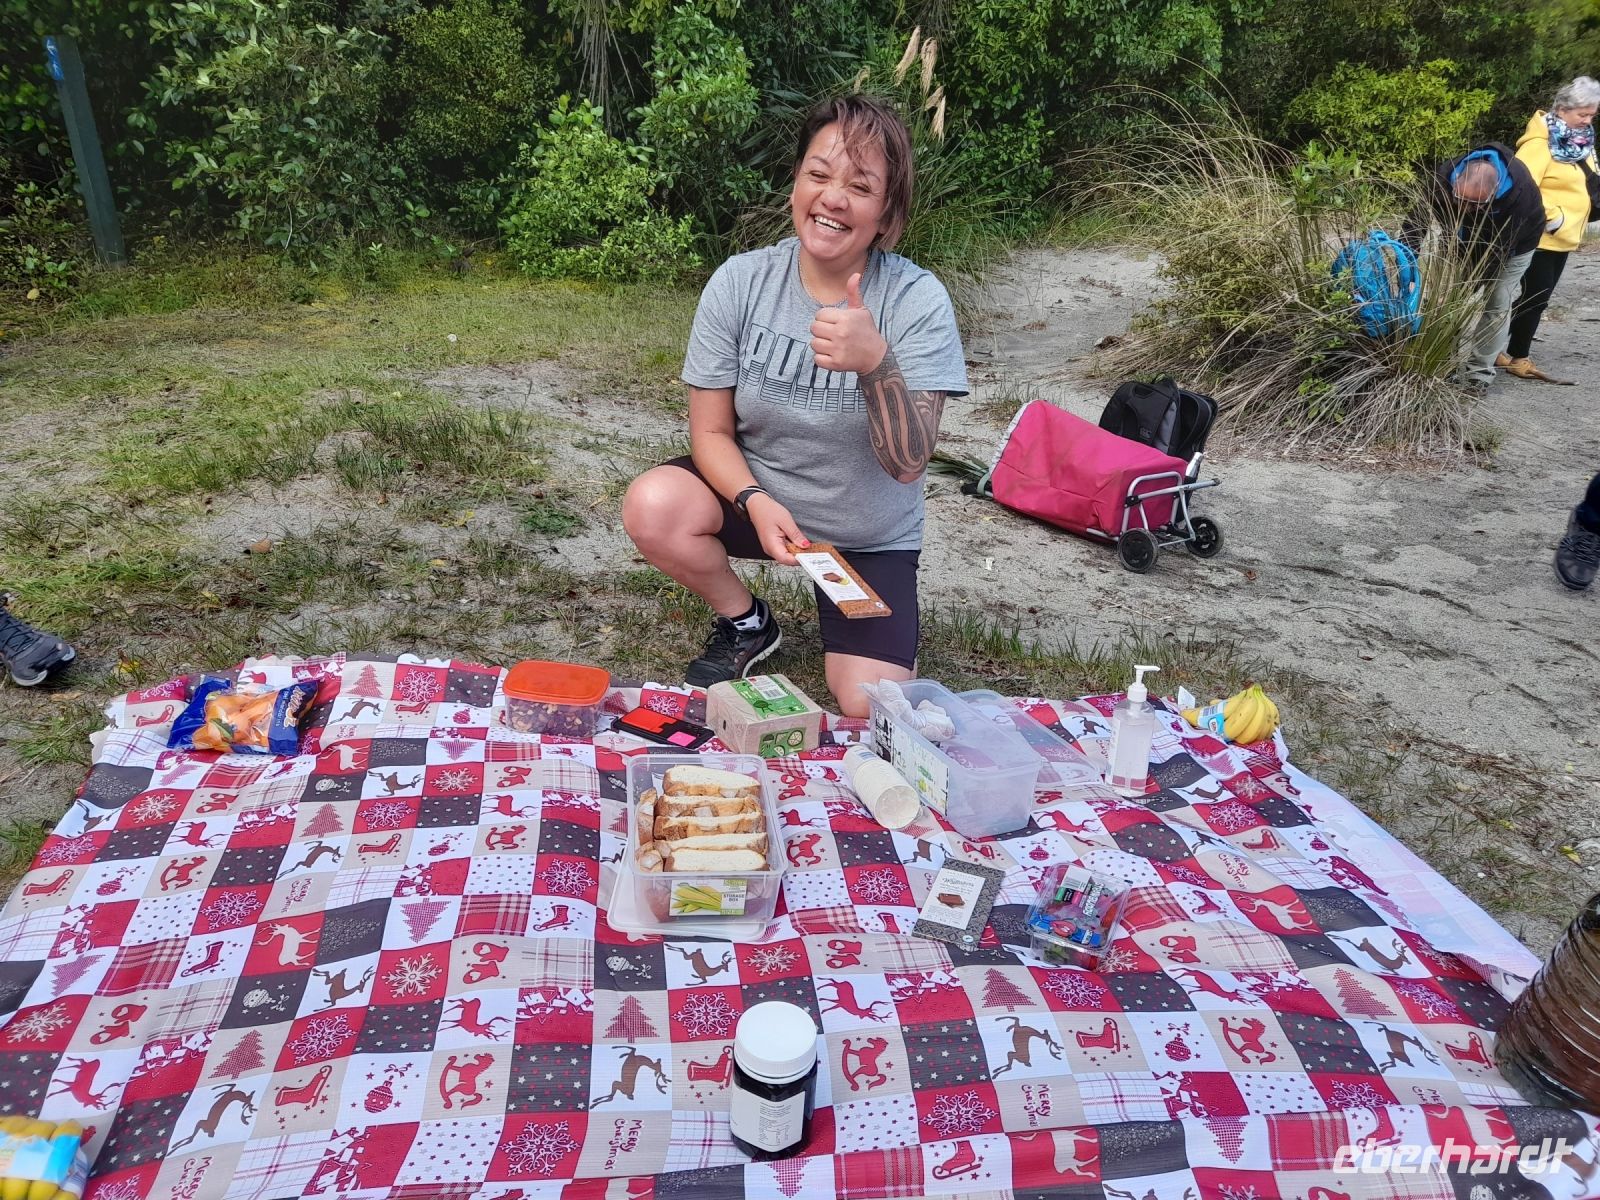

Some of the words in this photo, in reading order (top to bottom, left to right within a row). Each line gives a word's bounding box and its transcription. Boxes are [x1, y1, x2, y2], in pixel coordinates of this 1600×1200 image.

[1035, 1084, 1051, 1117] MERRY
[603, 1118, 626, 1170] Christmas
[620, 1119, 643, 1153] MERRY
